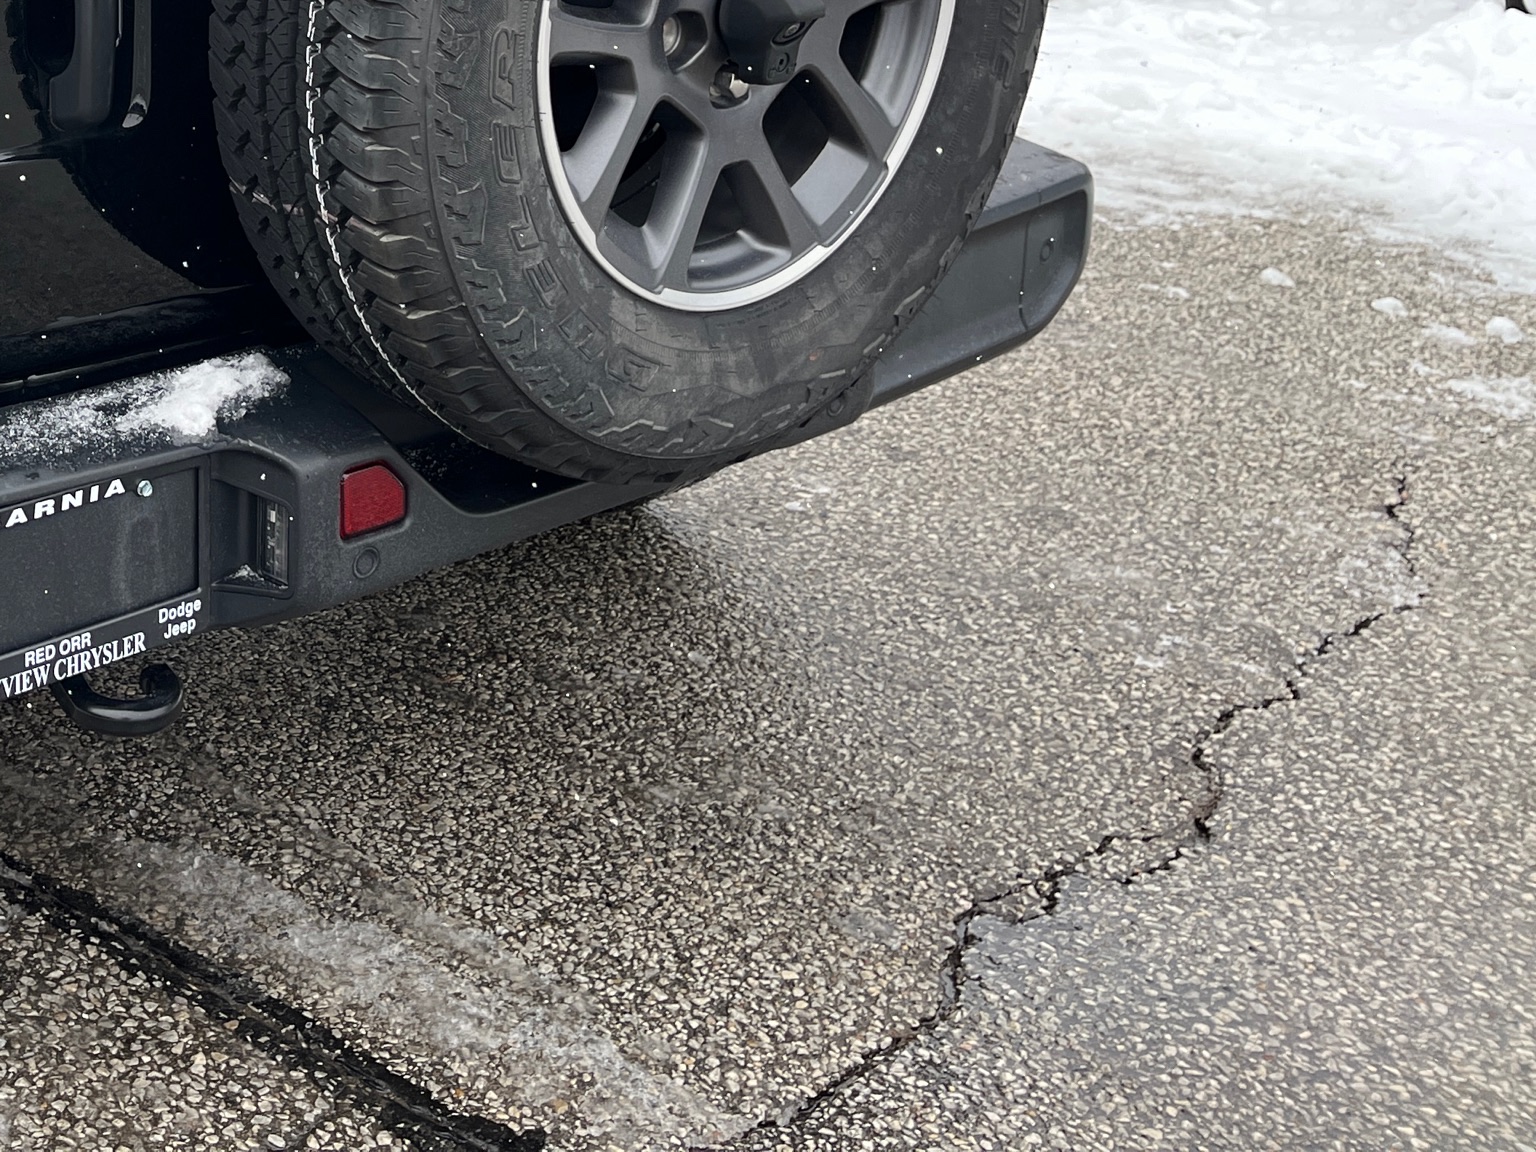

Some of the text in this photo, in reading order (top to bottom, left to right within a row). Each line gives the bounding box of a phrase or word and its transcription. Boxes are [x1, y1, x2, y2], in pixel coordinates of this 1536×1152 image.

[158, 598, 202, 624] Dodge
[163, 616, 197, 639] Jeep
[24, 632, 92, 668] RED ORR
[53, 631, 147, 681] CHRYSLER
